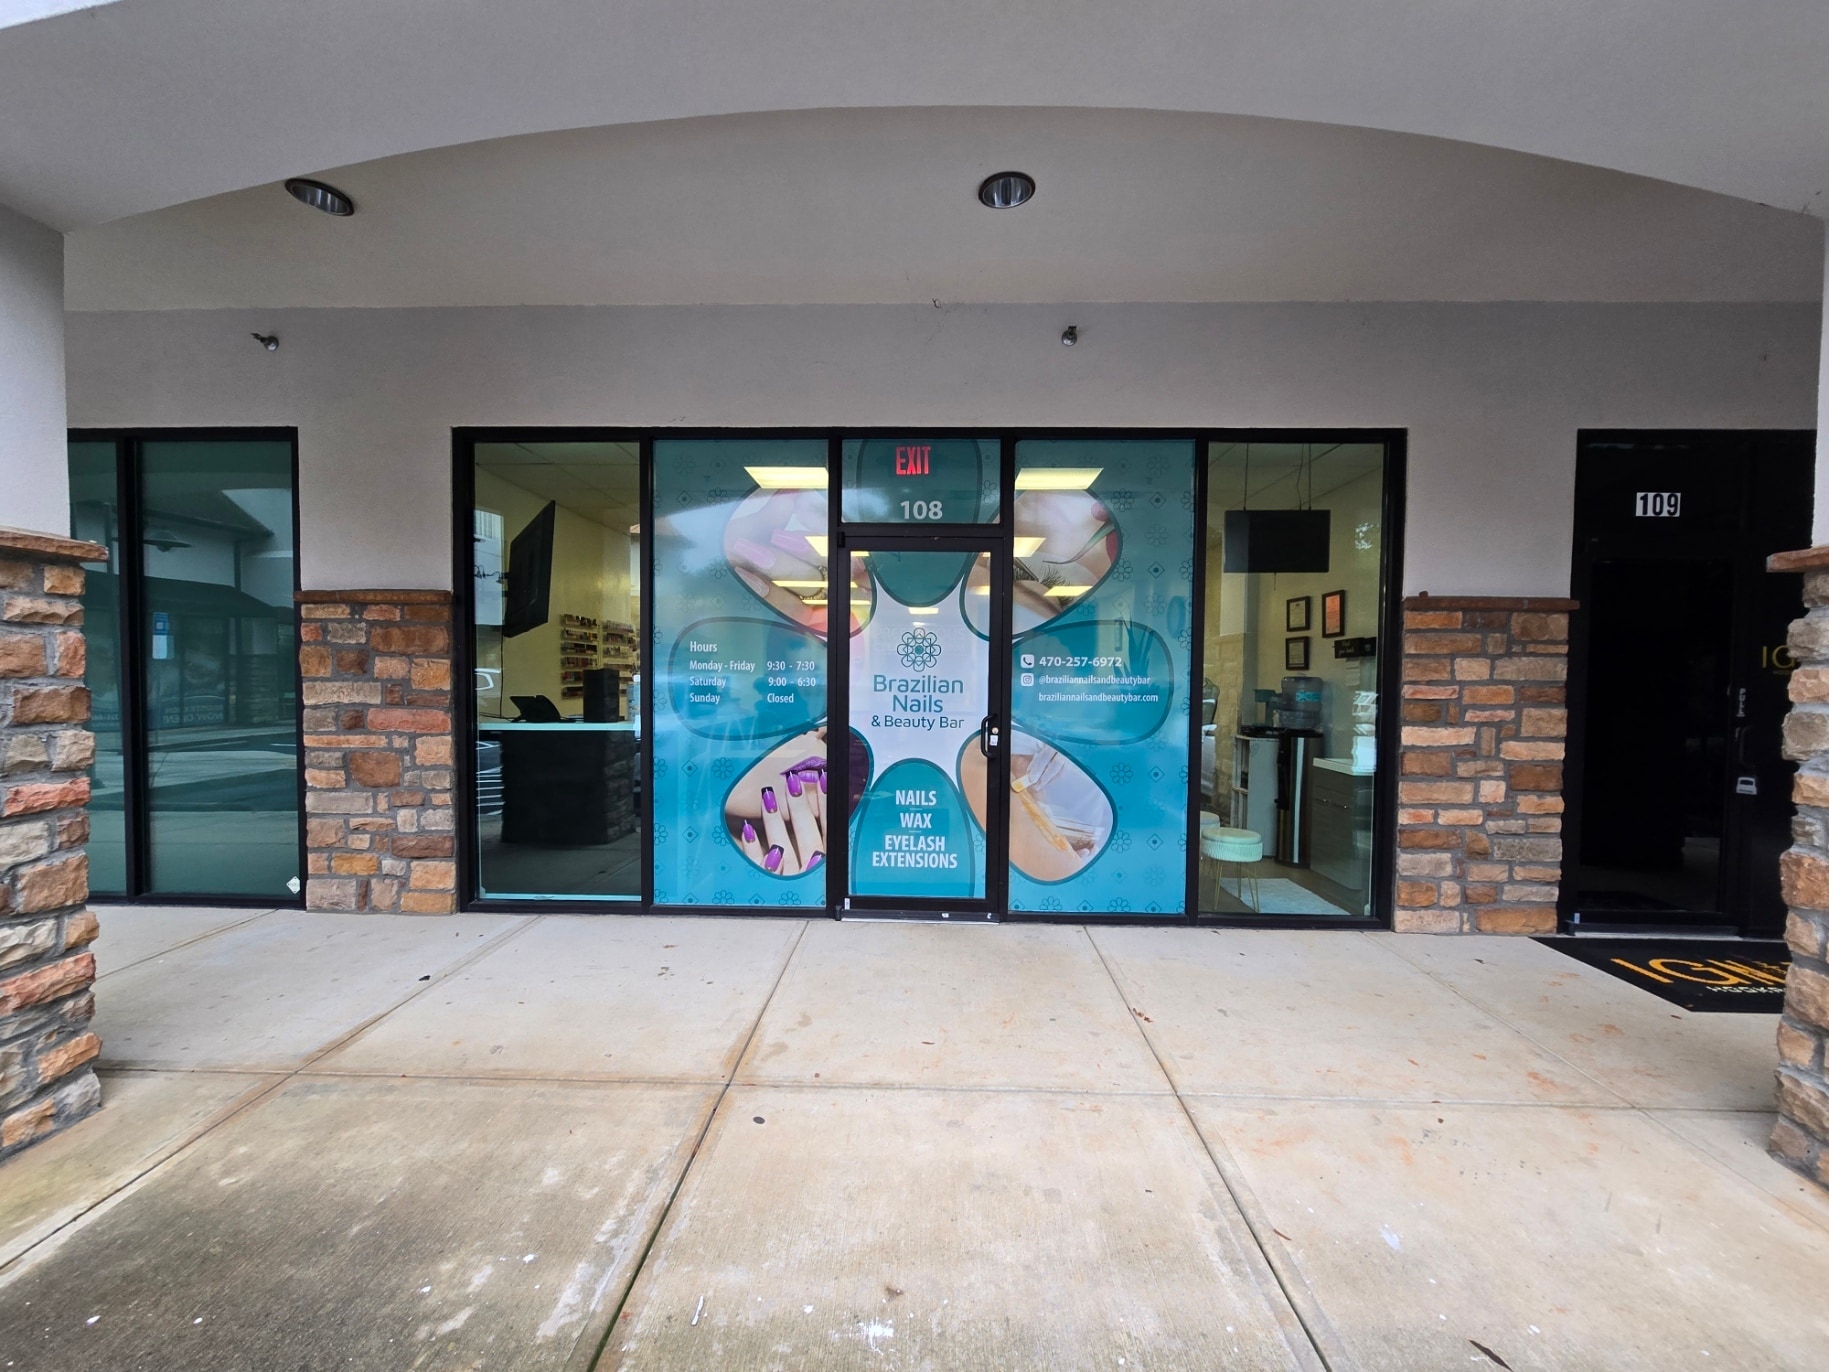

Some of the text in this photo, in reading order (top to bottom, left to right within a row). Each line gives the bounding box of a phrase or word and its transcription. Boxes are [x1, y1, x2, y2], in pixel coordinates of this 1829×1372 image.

[896, 446, 931, 475] EXIT
[900, 500, 943, 520] 108
[1640, 493, 1679, 516] 109
[690, 641, 718, 652] Hours
[689, 660, 723, 673] Monday
[730, 660, 755, 673] Friday
[767, 661, 785, 671] 9:30
[796, 661, 815, 671] 7:30
[1039, 657, 1122, 667] 470-257-6972
[689, 676, 726, 688] Saturday
[768, 677, 787, 687] 9:00
[797, 677, 816, 687] 6:30
[873, 674, 964, 694] Brazilian
[1039, 675, 1151, 686] @braziliannailsandbeautybar
[689, 692, 794, 705] Sunday Closed
[892, 694, 944, 713] Nails
[1038, 692, 1159, 703] braziliannailsandbeautybar.com
[871, 715, 965, 731] & Beauty Bar
[895, 789, 937, 806] NAILS
[900, 812, 932, 829] WAX
[885, 835, 946, 851] EYELASH
[872, 851, 958, 869] EXTENSIONS
